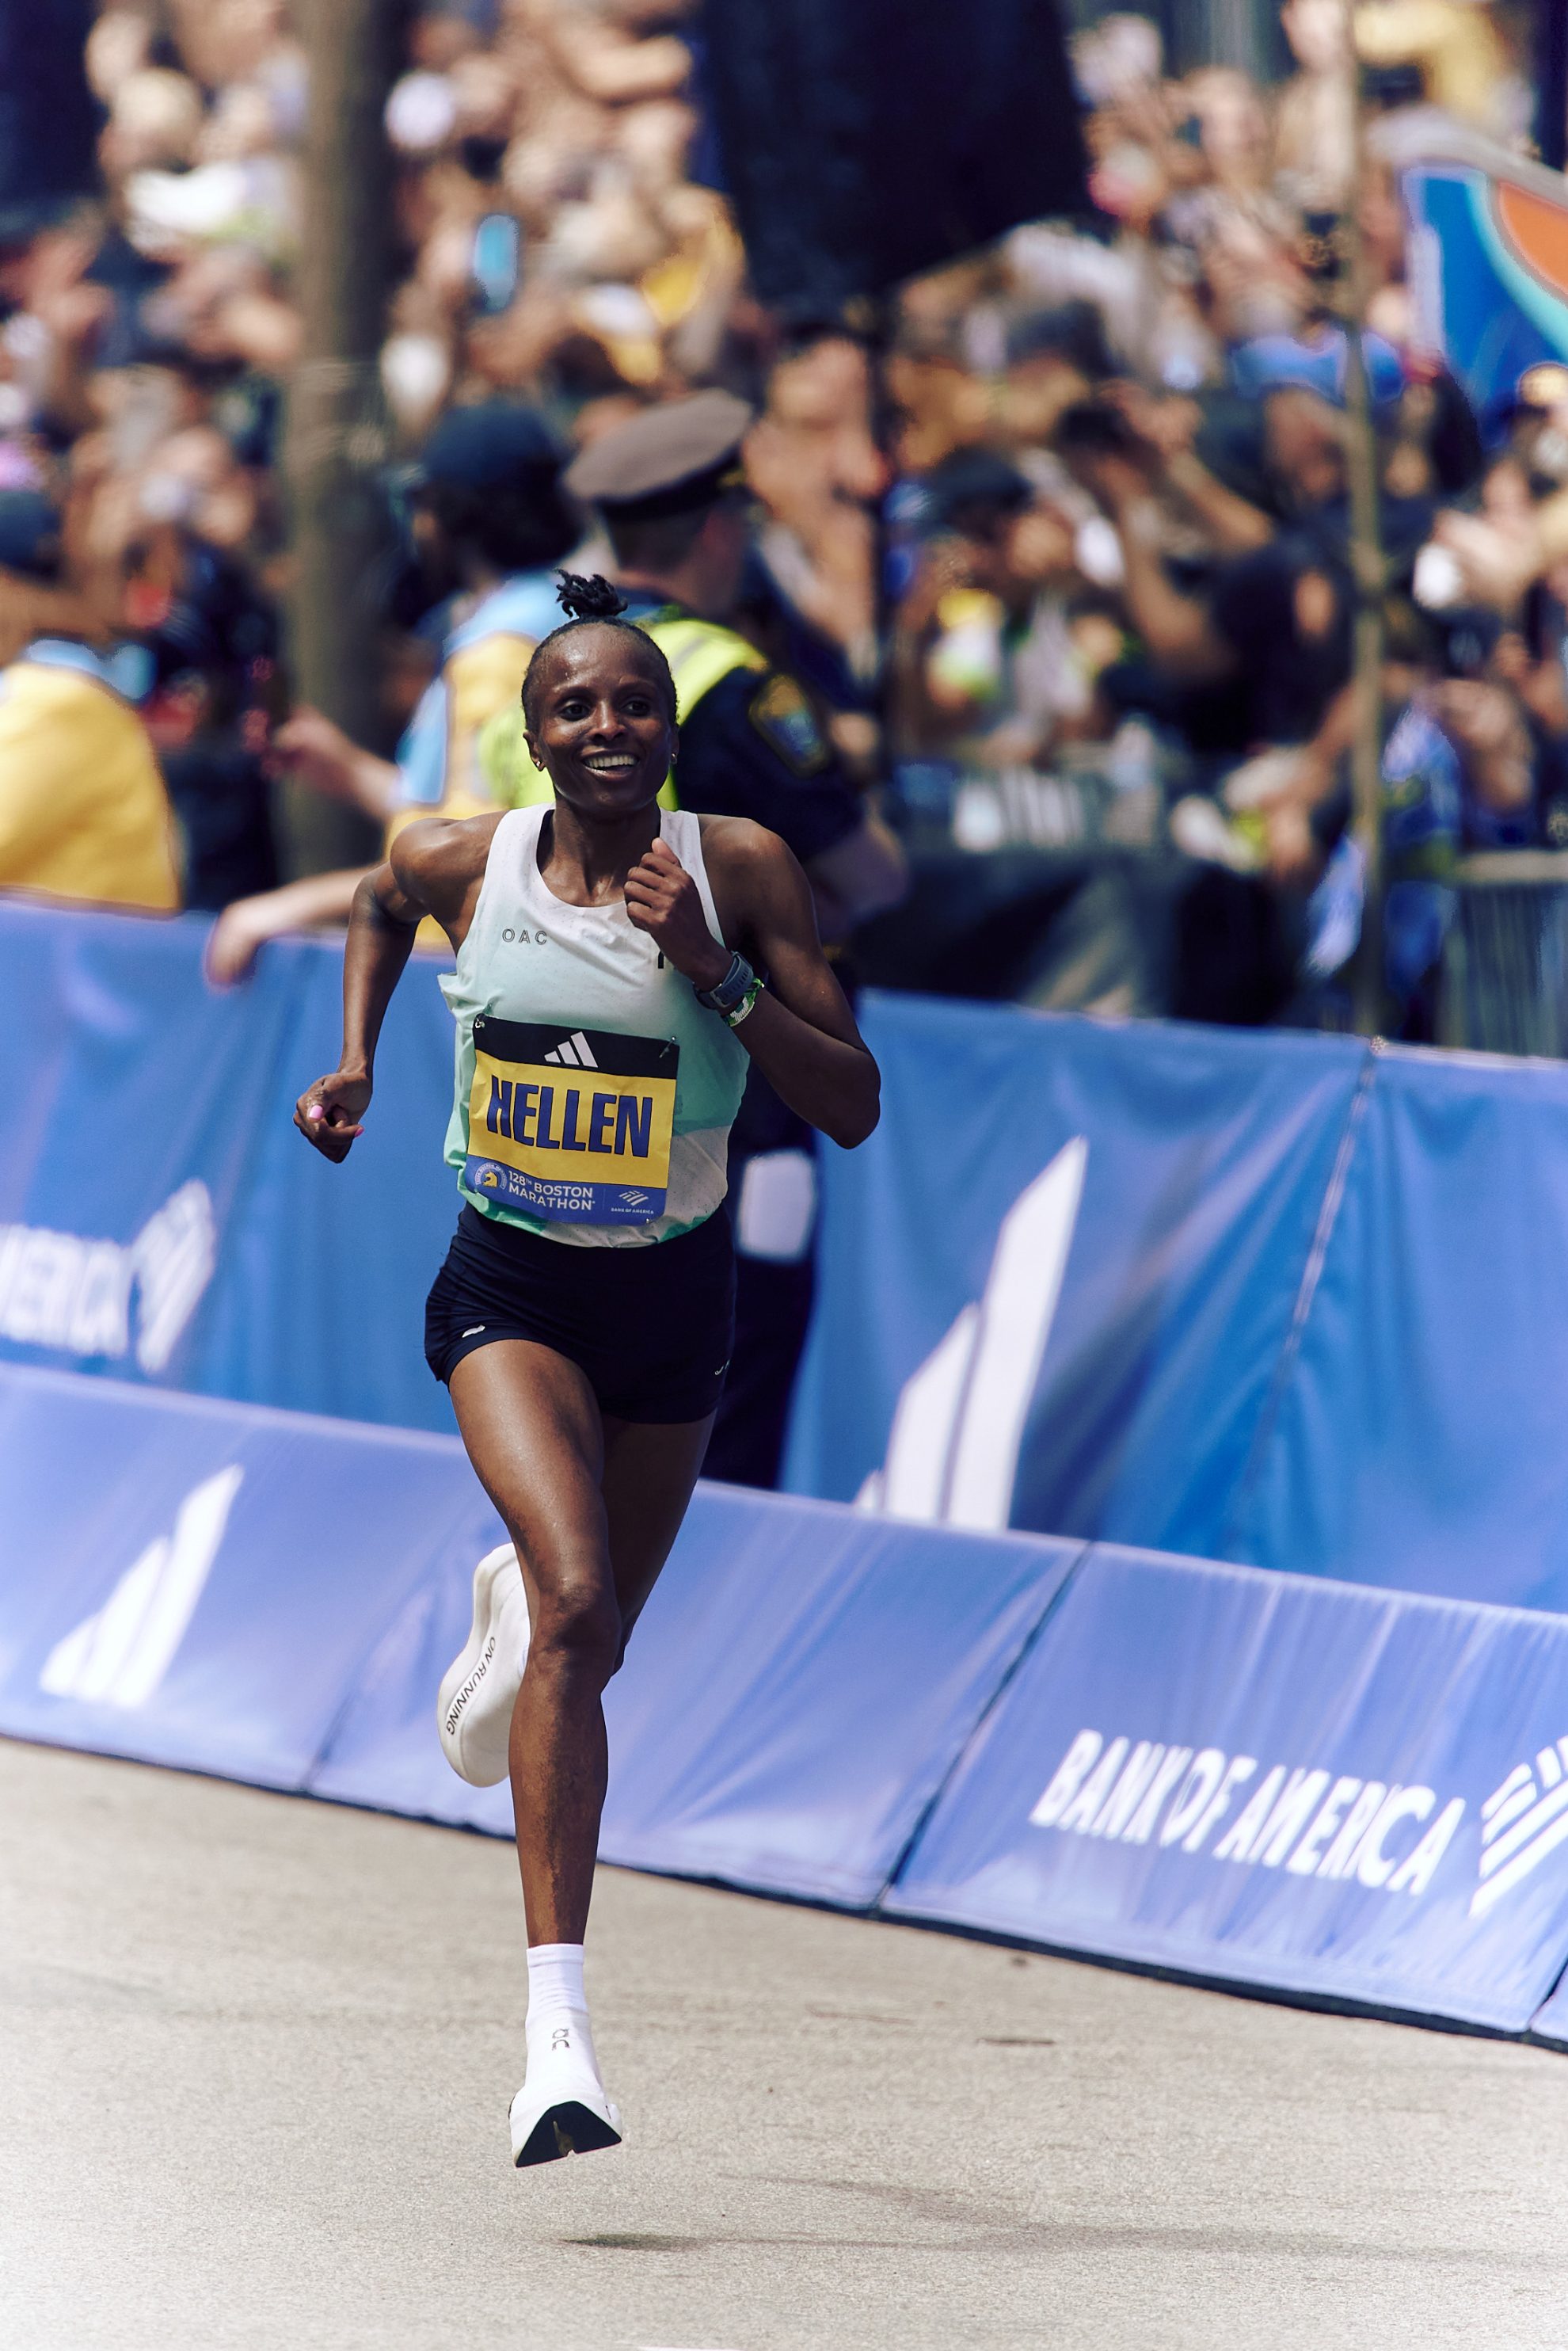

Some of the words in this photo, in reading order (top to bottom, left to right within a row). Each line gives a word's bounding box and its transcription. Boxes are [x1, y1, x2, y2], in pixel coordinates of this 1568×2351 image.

[502, 928, 547, 945] OAC
[486, 1075, 653, 1157] HELLEN
[508, 1182, 592, 1210] MARATHON
[534, 1182, 593, 1198] BOSTON
[485, 1637, 496, 1665] ON
[446, 1661, 487, 1736] RUNNING
[1029, 1728, 1194, 1846] BANK
[1159, 1747, 1258, 1854] OF
[1212, 1765, 1466, 1896] AMERICA
